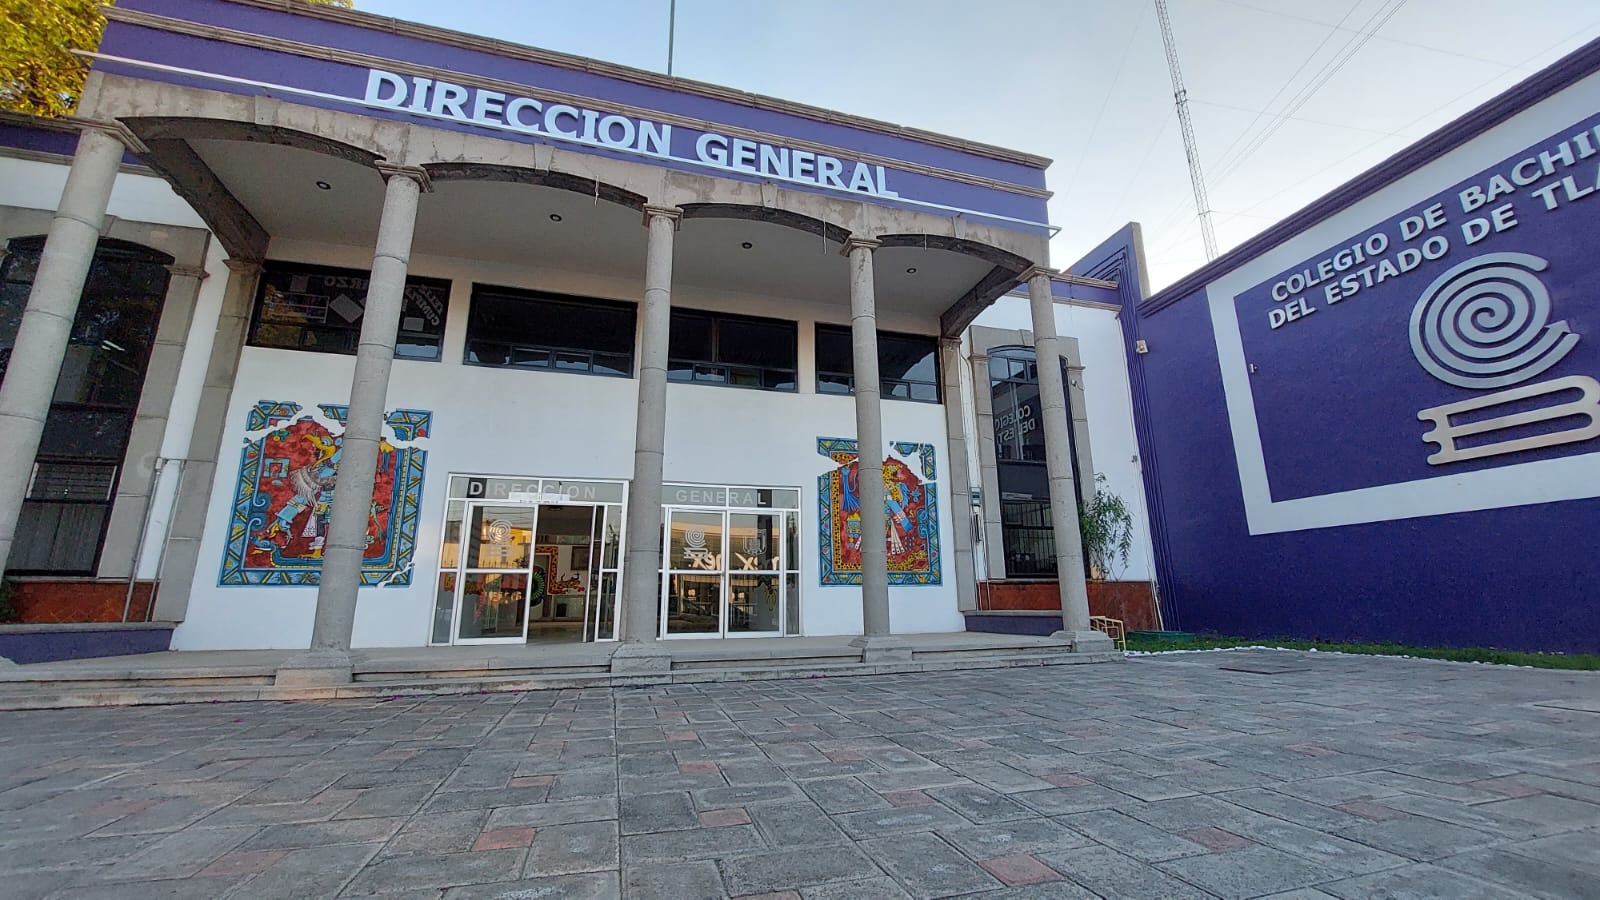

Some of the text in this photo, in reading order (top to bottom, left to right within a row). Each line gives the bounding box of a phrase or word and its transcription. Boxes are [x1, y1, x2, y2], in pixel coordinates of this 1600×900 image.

[364, 68, 899, 198] DIRECCION GENERAL
[1268, 161, 1600, 329] DEL ESTADO DE TL
[1271, 123, 1600, 301] COLEGIO DE BACHI
[675, 489, 767, 505] GENERAL
